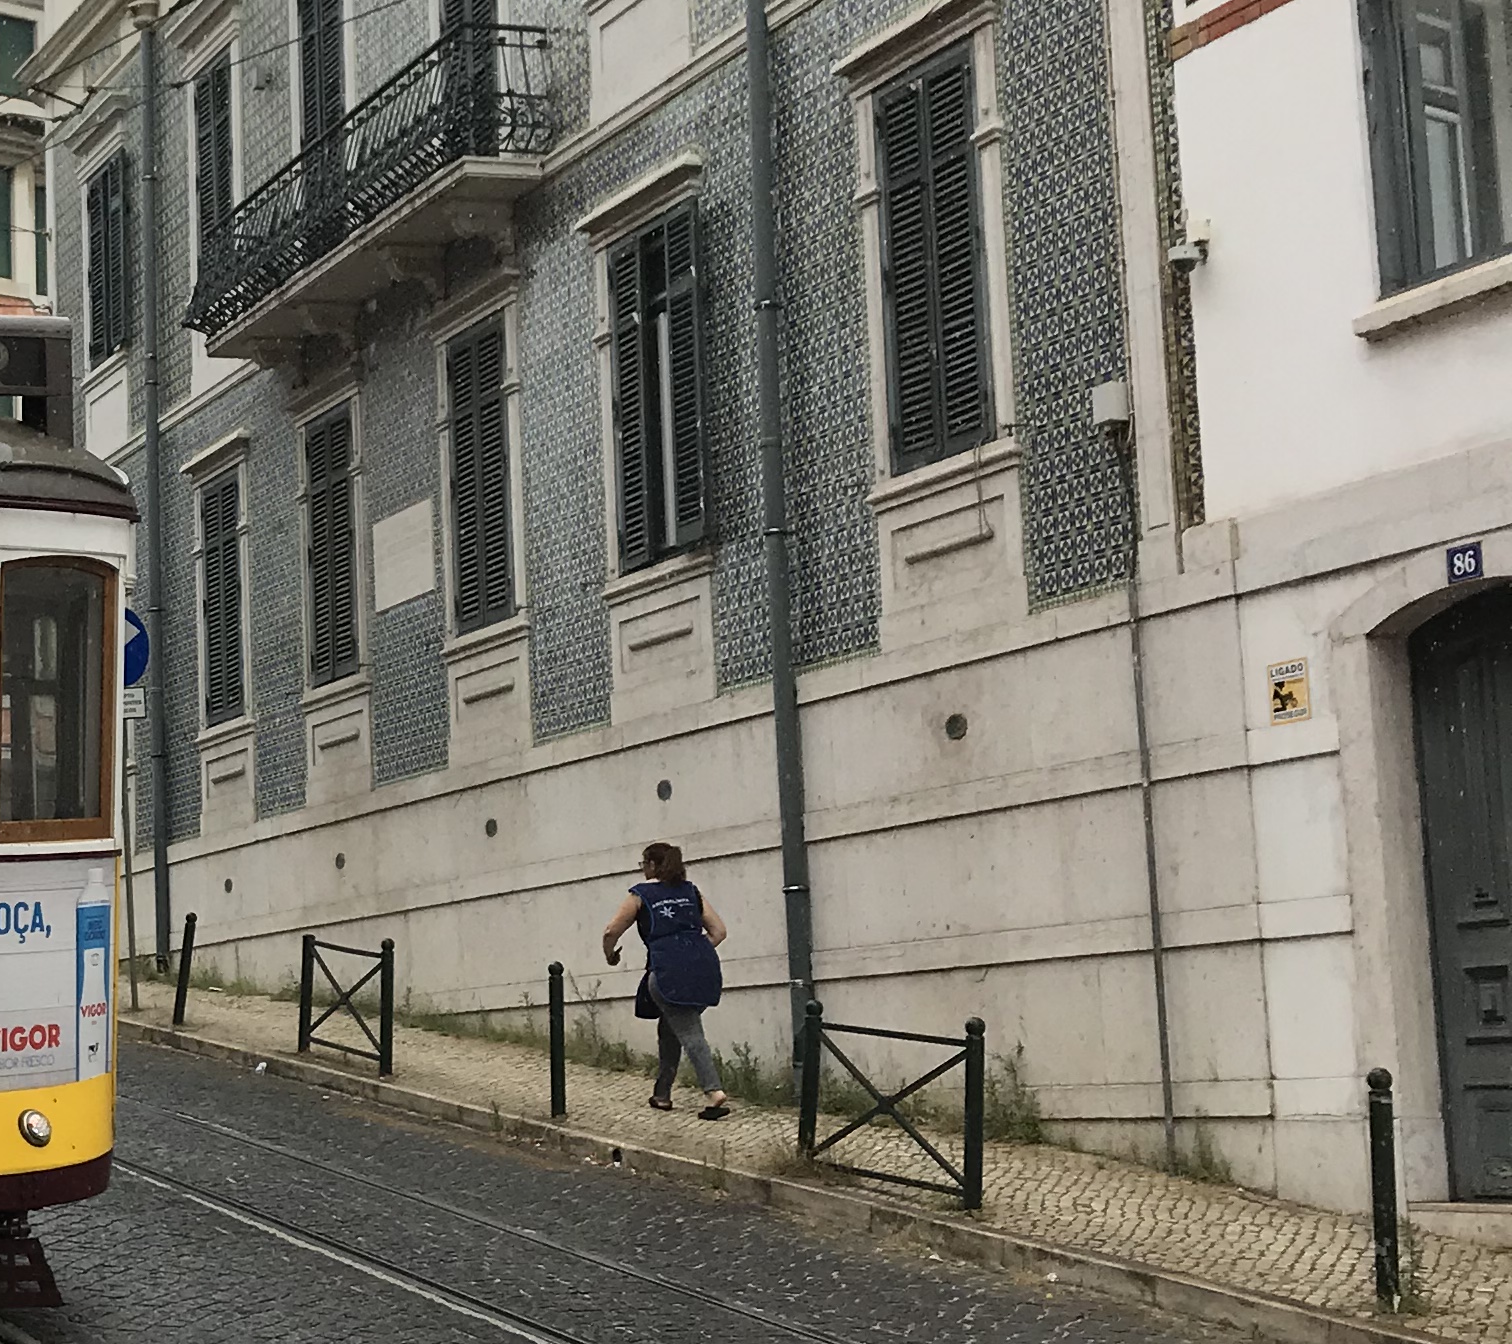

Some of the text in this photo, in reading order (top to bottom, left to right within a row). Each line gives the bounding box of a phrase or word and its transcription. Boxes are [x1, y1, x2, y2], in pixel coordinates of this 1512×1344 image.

[1453, 550, 1476, 576] 86
[1270, 662, 1304, 678] LIGADO
[80, 1002, 106, 1017] VIGOR
